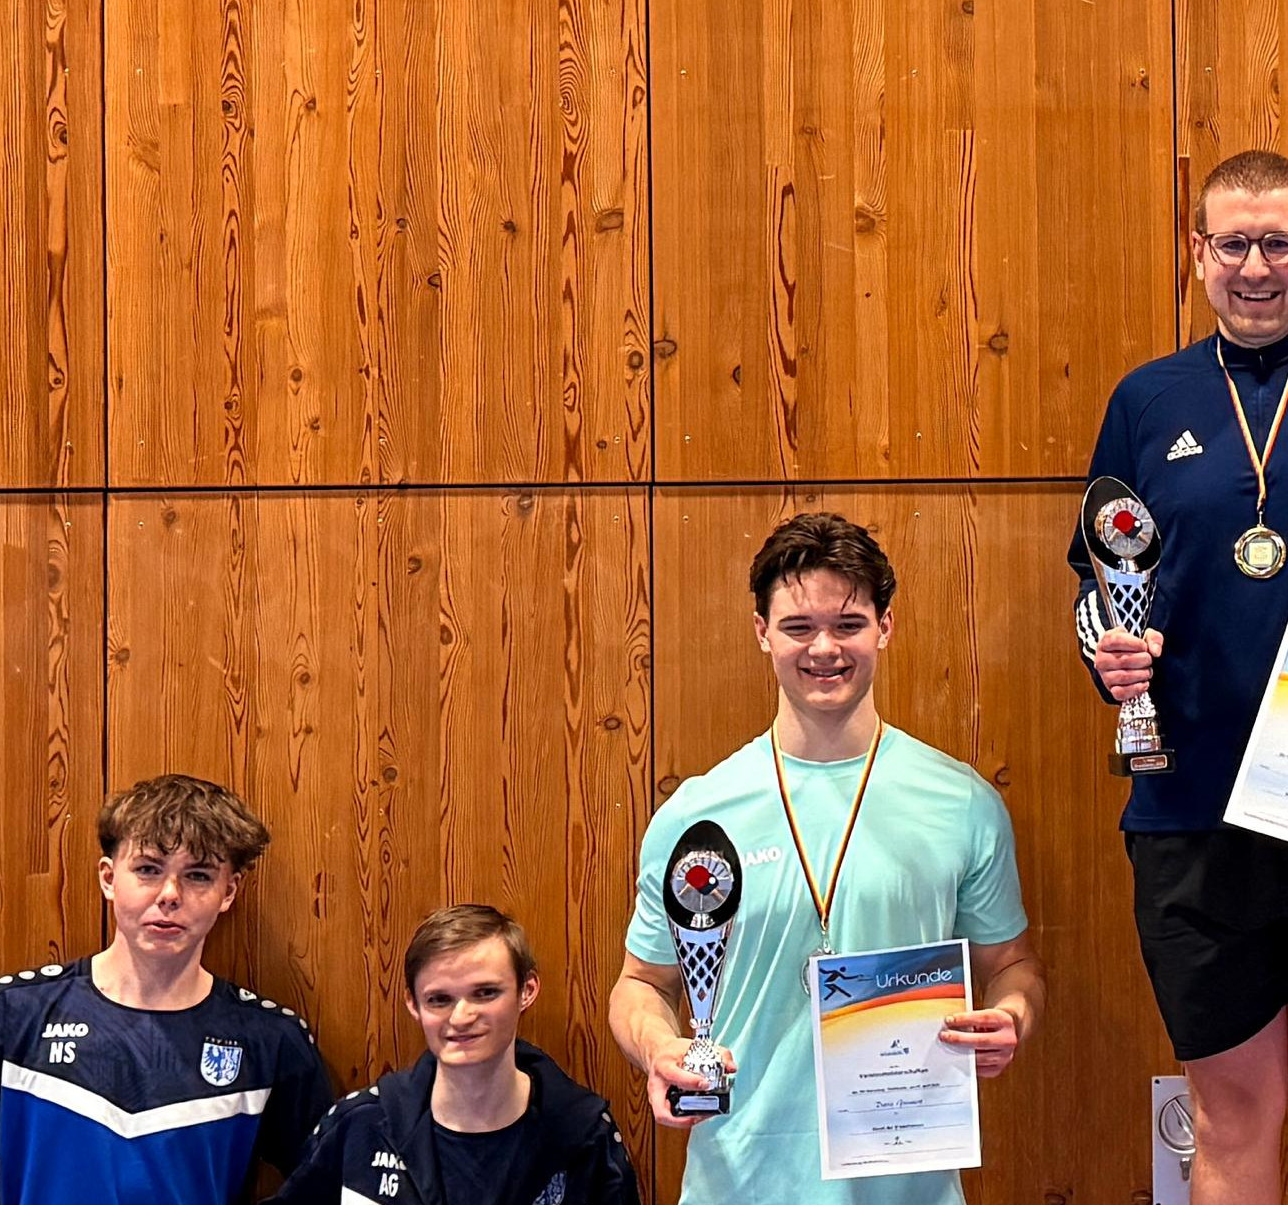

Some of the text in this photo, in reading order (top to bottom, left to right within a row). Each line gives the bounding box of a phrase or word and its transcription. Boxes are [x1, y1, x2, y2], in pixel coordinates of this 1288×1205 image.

[741, 846, 782, 866] AKO
[875, 968, 953, 989] Urkunde
[41, 1023, 89, 1038] JAKO
[379, 1173, 399, 1197] AG
